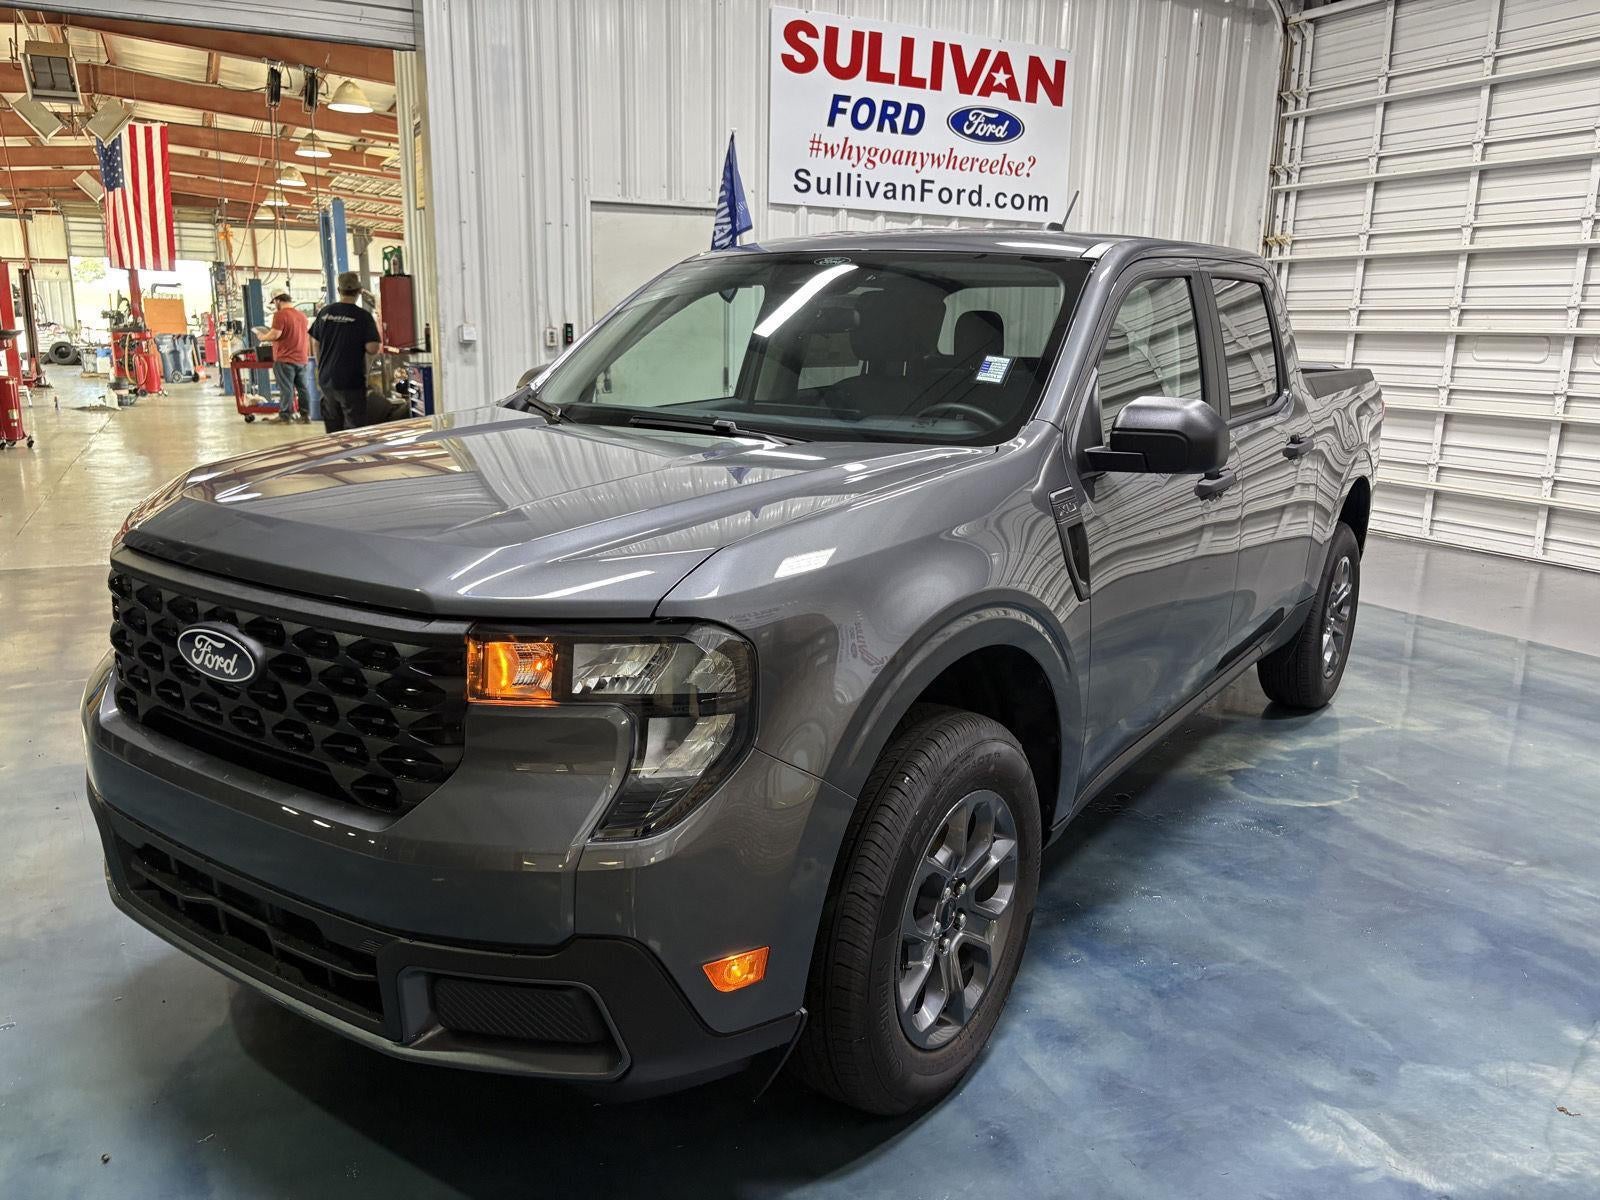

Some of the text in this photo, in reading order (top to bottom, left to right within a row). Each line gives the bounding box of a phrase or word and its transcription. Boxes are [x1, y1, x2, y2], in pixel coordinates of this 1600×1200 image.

[781, 19, 1067, 108] SULLIVAN
[827, 93, 926, 136] FORD
[963, 109, 1010, 139] Ford
[808, 132, 1037, 178] #whygoanywhereelse?
[793, 167, 1049, 212] SullivanFord.com
[191, 634, 238, 676] Ford
